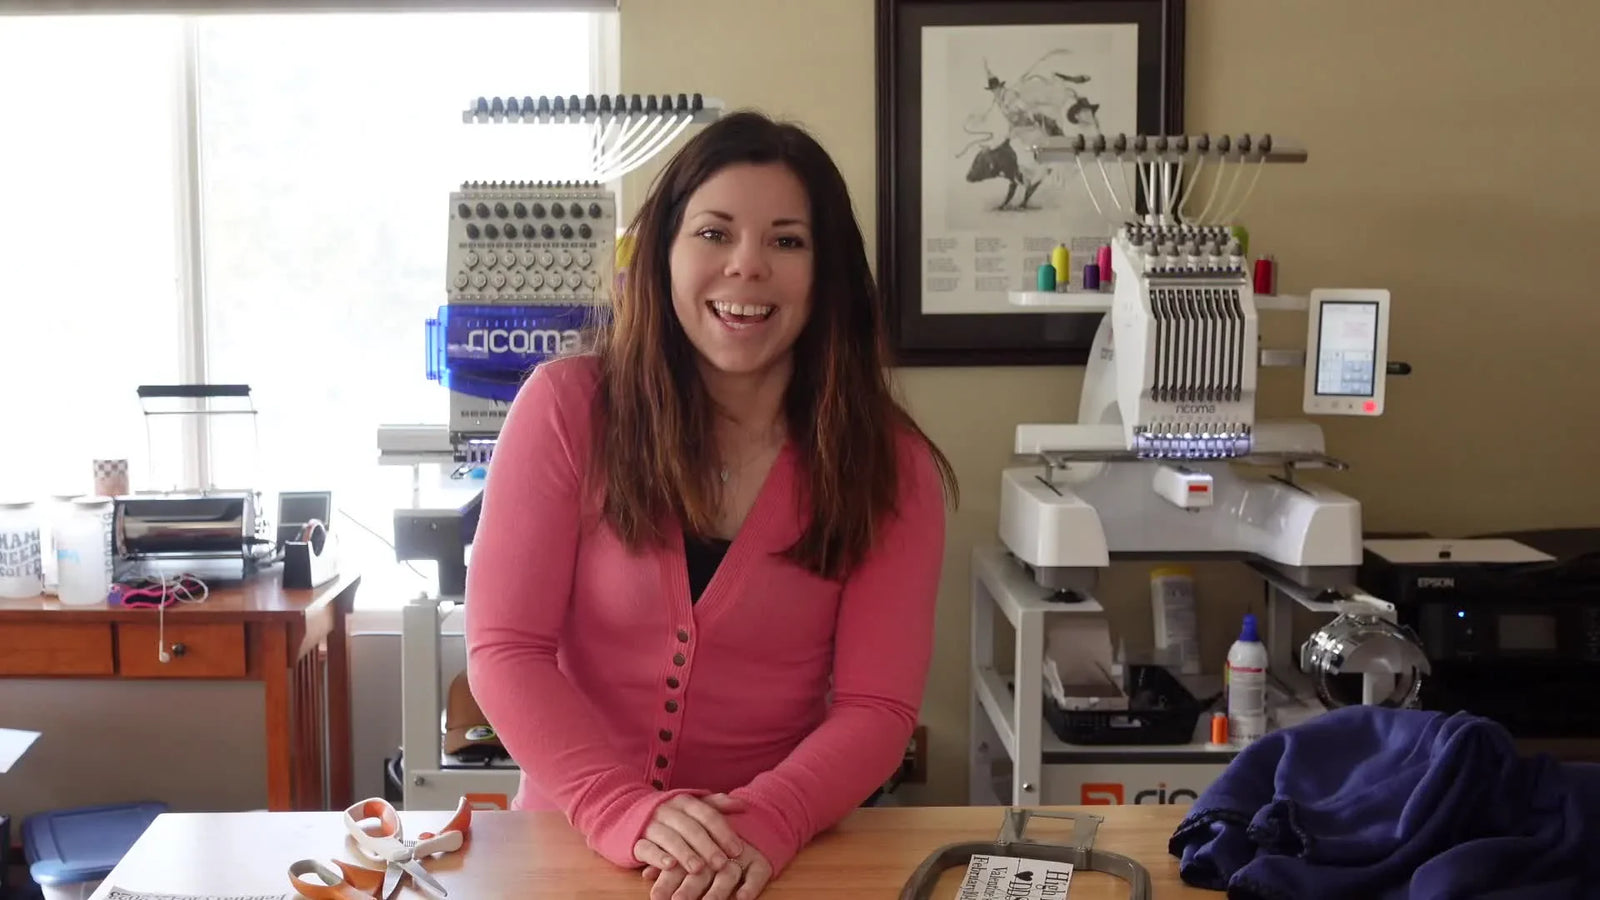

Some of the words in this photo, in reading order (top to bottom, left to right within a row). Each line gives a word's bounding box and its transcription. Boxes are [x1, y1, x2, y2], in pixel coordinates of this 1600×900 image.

[467, 328, 582, 354] ricoma
[1175, 403, 1216, 414] ricoma
[1417, 577, 1455, 588] EPSON
[960, 856, 990, 891] February
[1036, 869, 1070, 896] High
